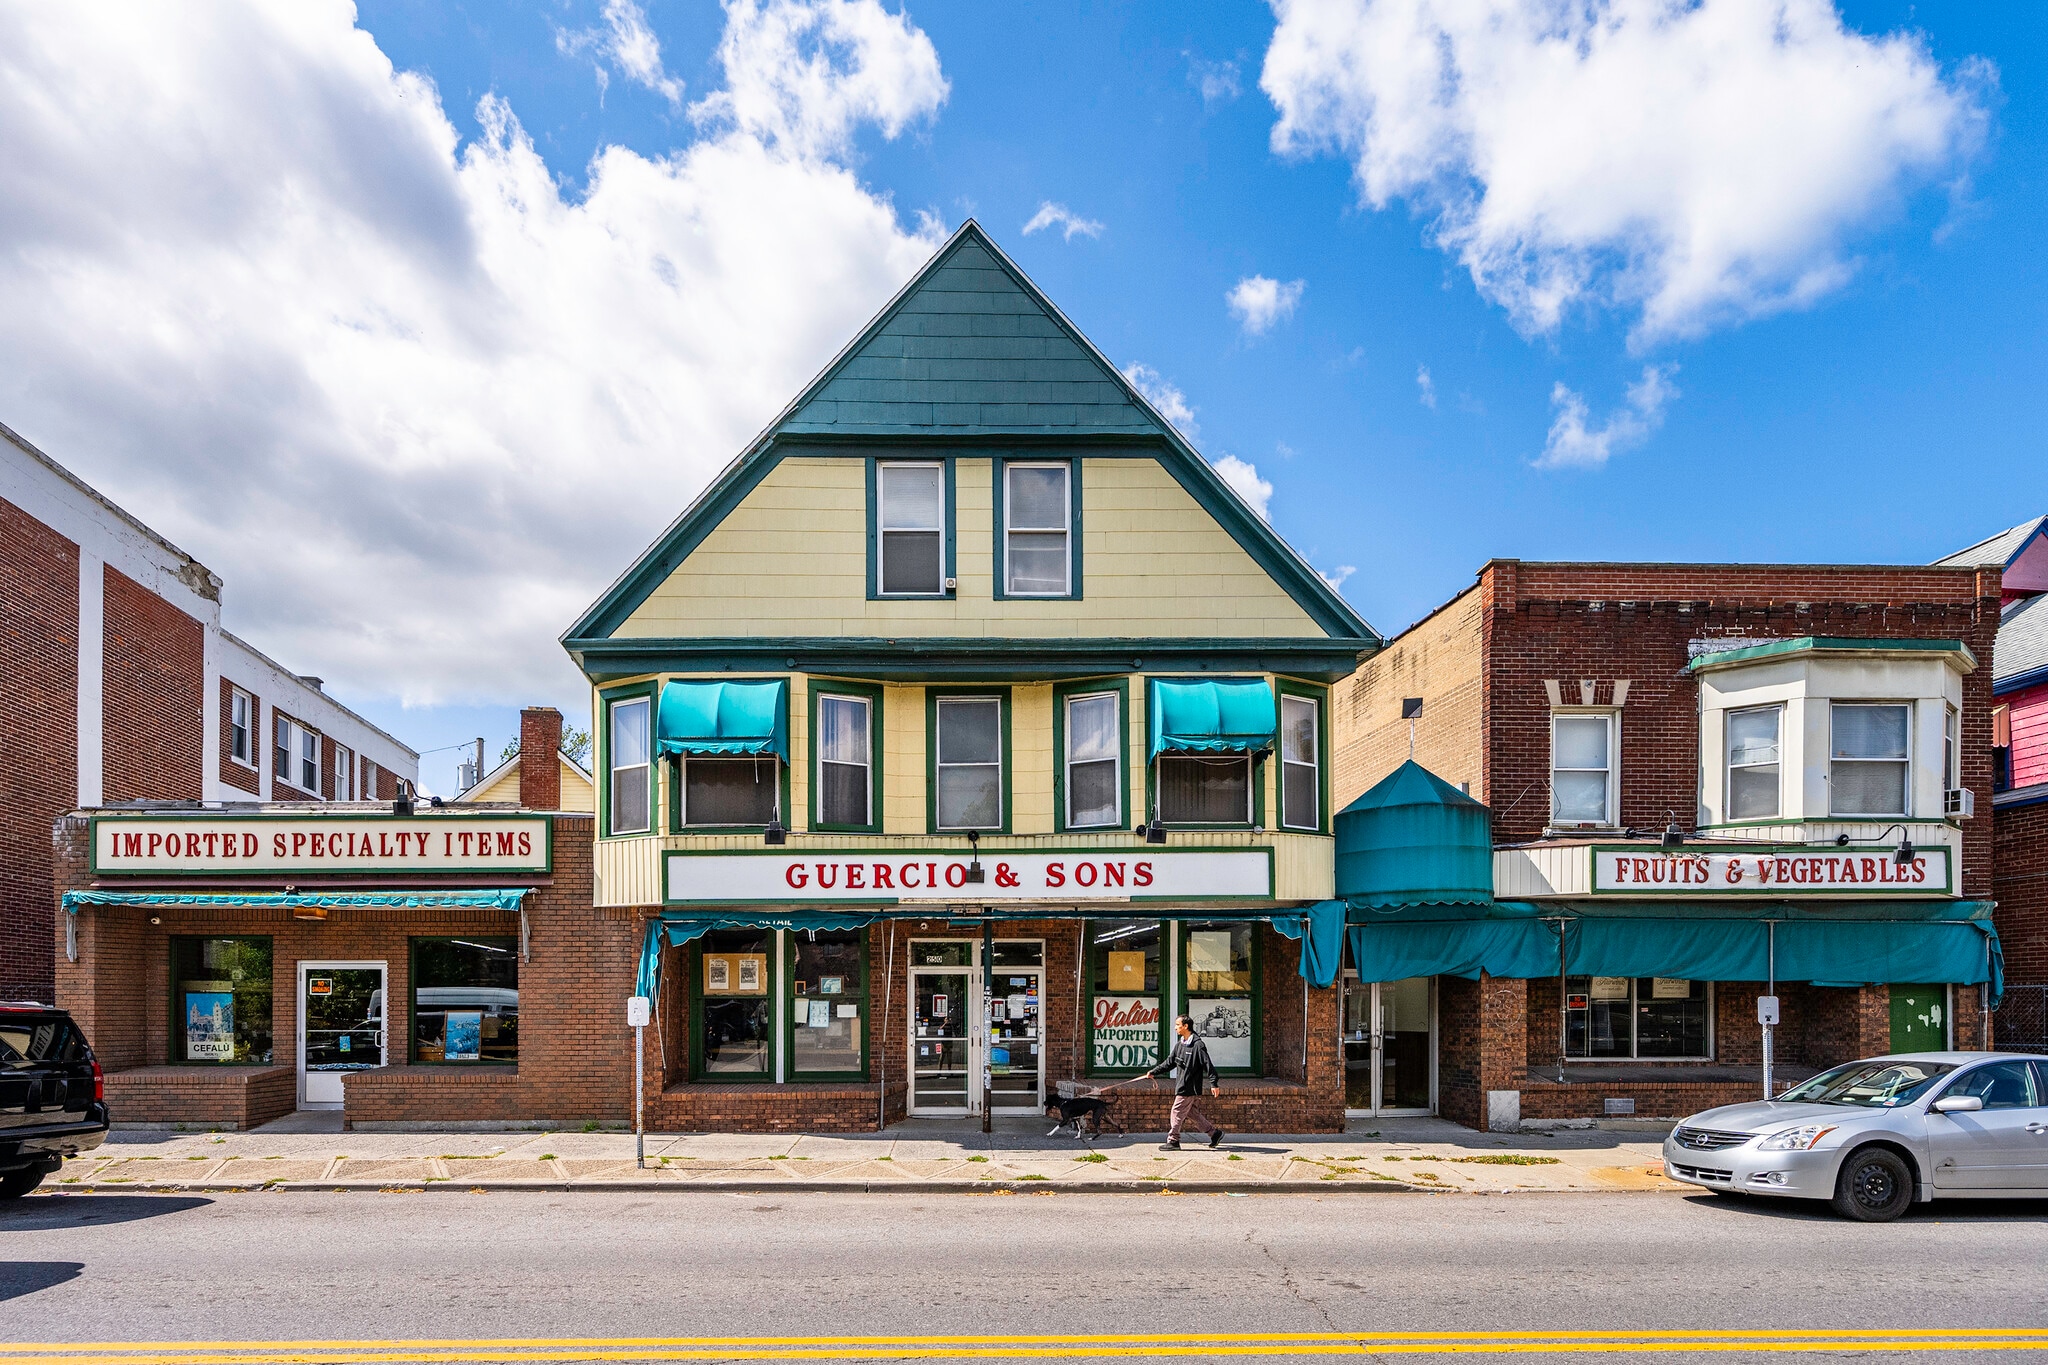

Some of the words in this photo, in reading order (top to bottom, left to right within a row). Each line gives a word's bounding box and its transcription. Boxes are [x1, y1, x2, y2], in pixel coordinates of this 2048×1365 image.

[111, 833, 259, 857] IMPORTED
[273, 832, 431, 858] SPECIALTY
[444, 831, 532, 856] ITEMS
[785, 863, 967, 889] GUERCIO
[994, 862, 1021, 887] &
[1045, 861, 1154, 888] SONS
[1615, 857, 1709, 883] FRUITS
[1725, 858, 1742, 883] &
[1756, 857, 1926, 883] VEGETABLES
[1094, 999, 1159, 1029] Italian
[1094, 1043, 1159, 1067] FOODS
